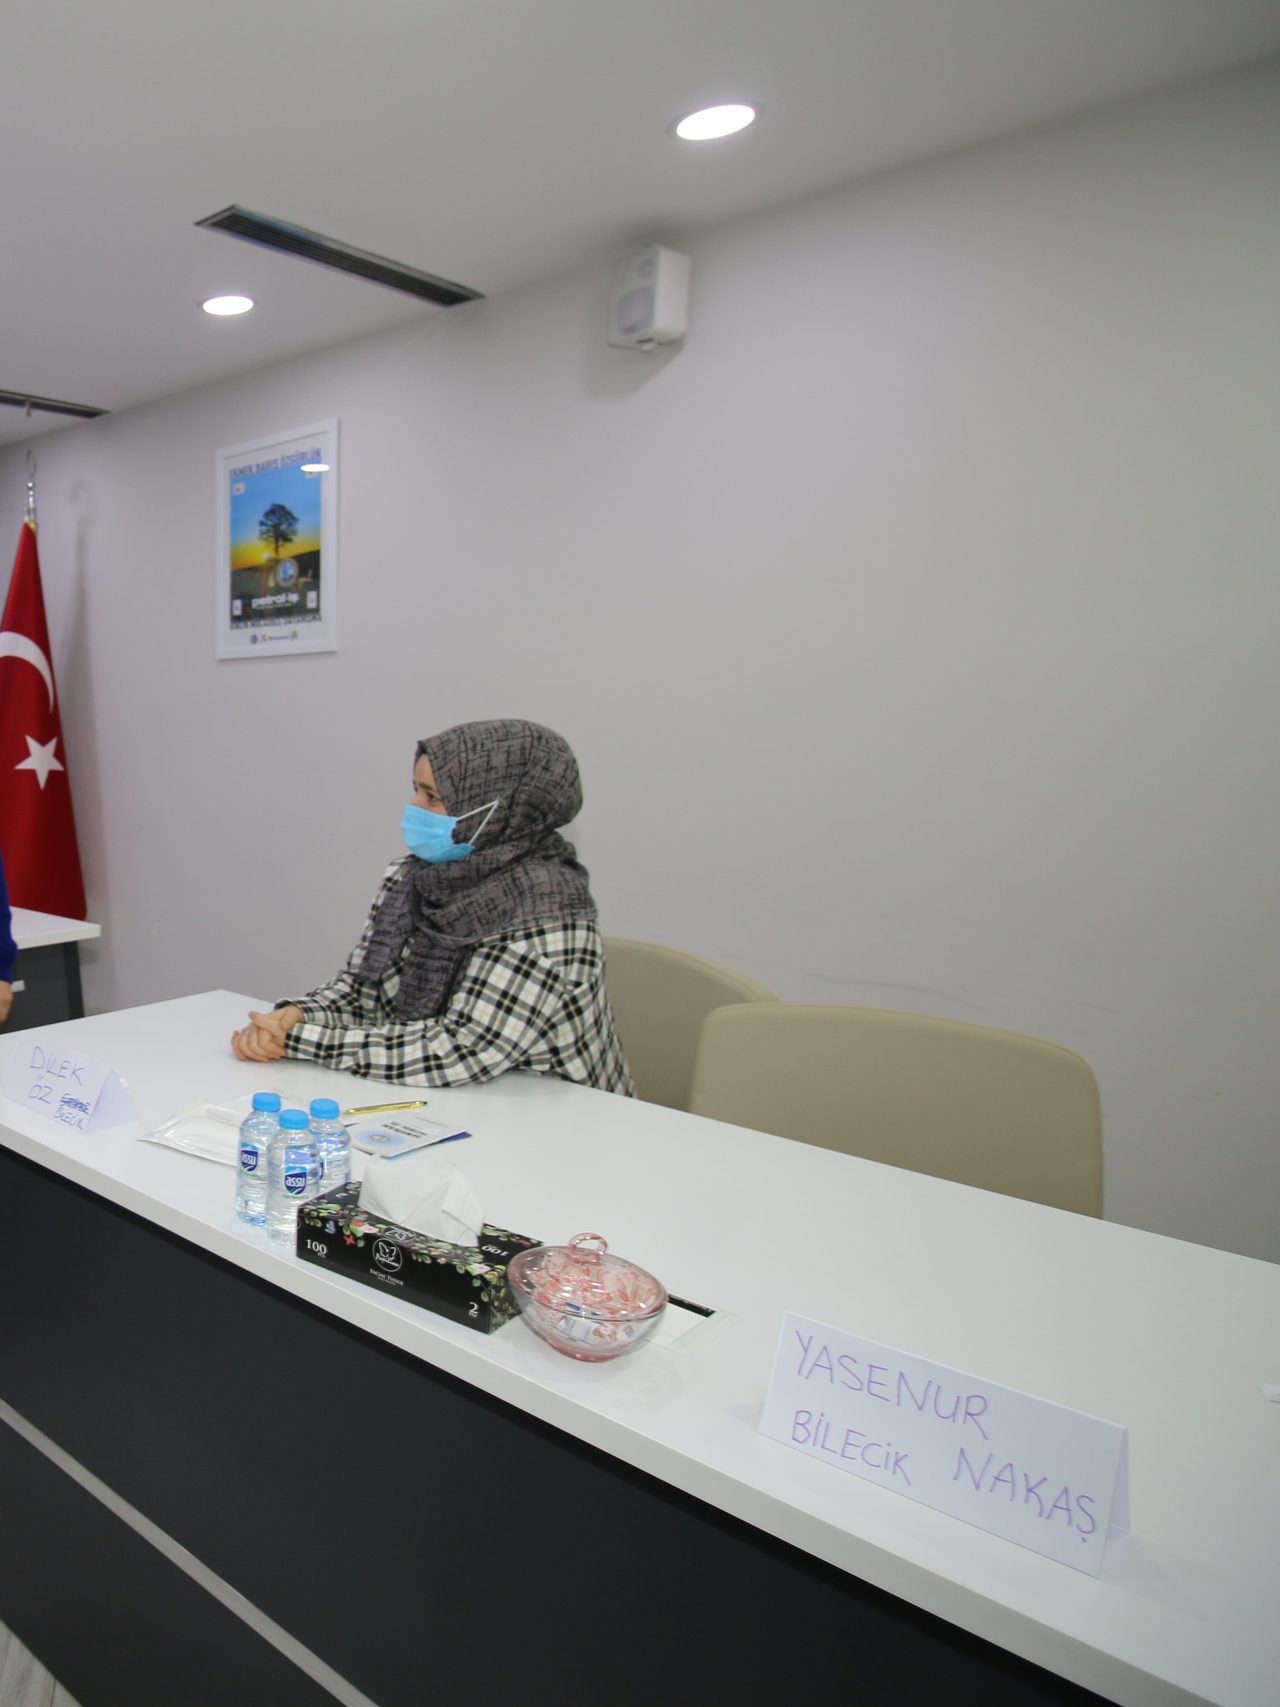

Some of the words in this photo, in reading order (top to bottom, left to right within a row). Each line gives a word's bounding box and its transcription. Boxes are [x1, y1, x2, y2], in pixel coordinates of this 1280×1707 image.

[286, 1176, 306, 1188] assu
[306, 1239, 328, 1256] 100
[468, 1301, 479, 1313] 2
[794, 1329, 990, 1441] YASENUR
[791, 1409, 912, 1487] BİLECİK
[952, 1446, 1097, 1544] NAKAŞ
